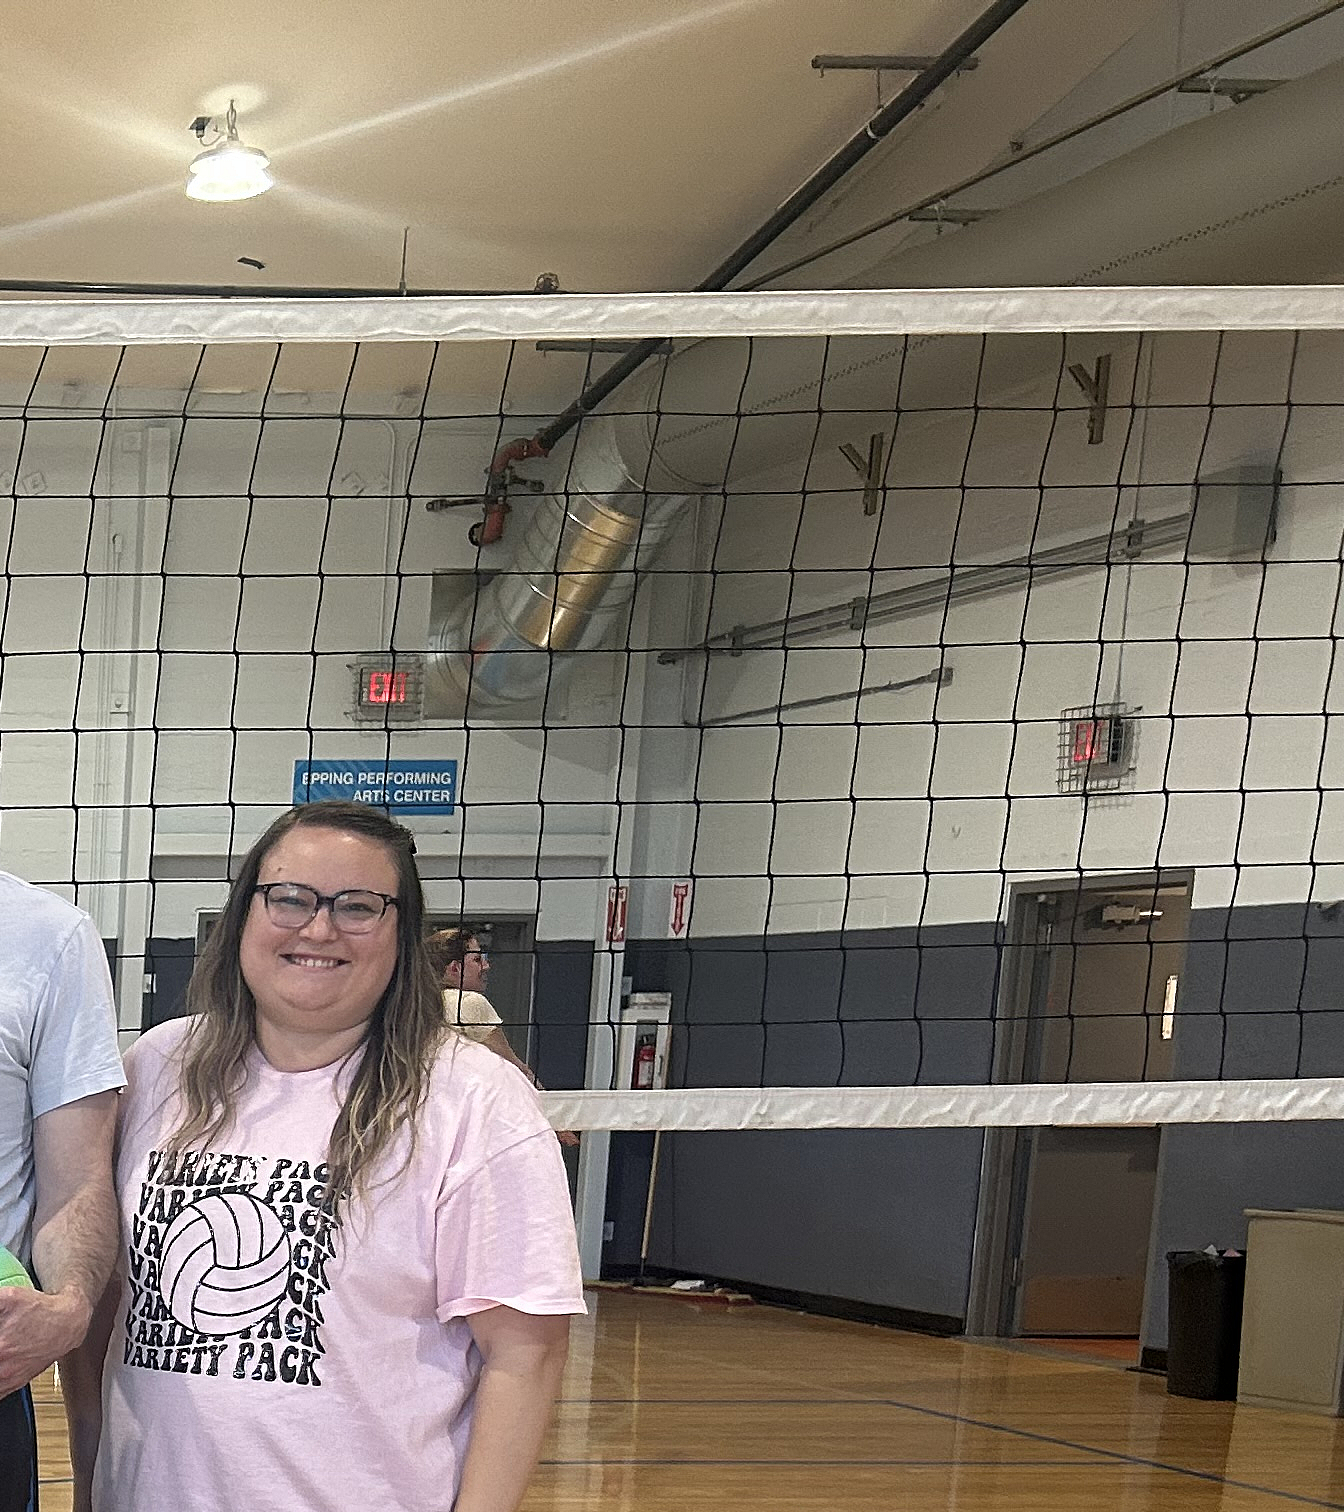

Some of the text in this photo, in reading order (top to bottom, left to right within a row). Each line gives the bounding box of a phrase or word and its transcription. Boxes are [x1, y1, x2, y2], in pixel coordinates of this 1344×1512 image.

[301, 772, 452, 785] EPPING PERFORMING
[352, 790, 451, 802] ARTS CENTER
[269, 1158, 330, 1184] PAC
[124, 1337, 322, 1387] VARIETY PACK
